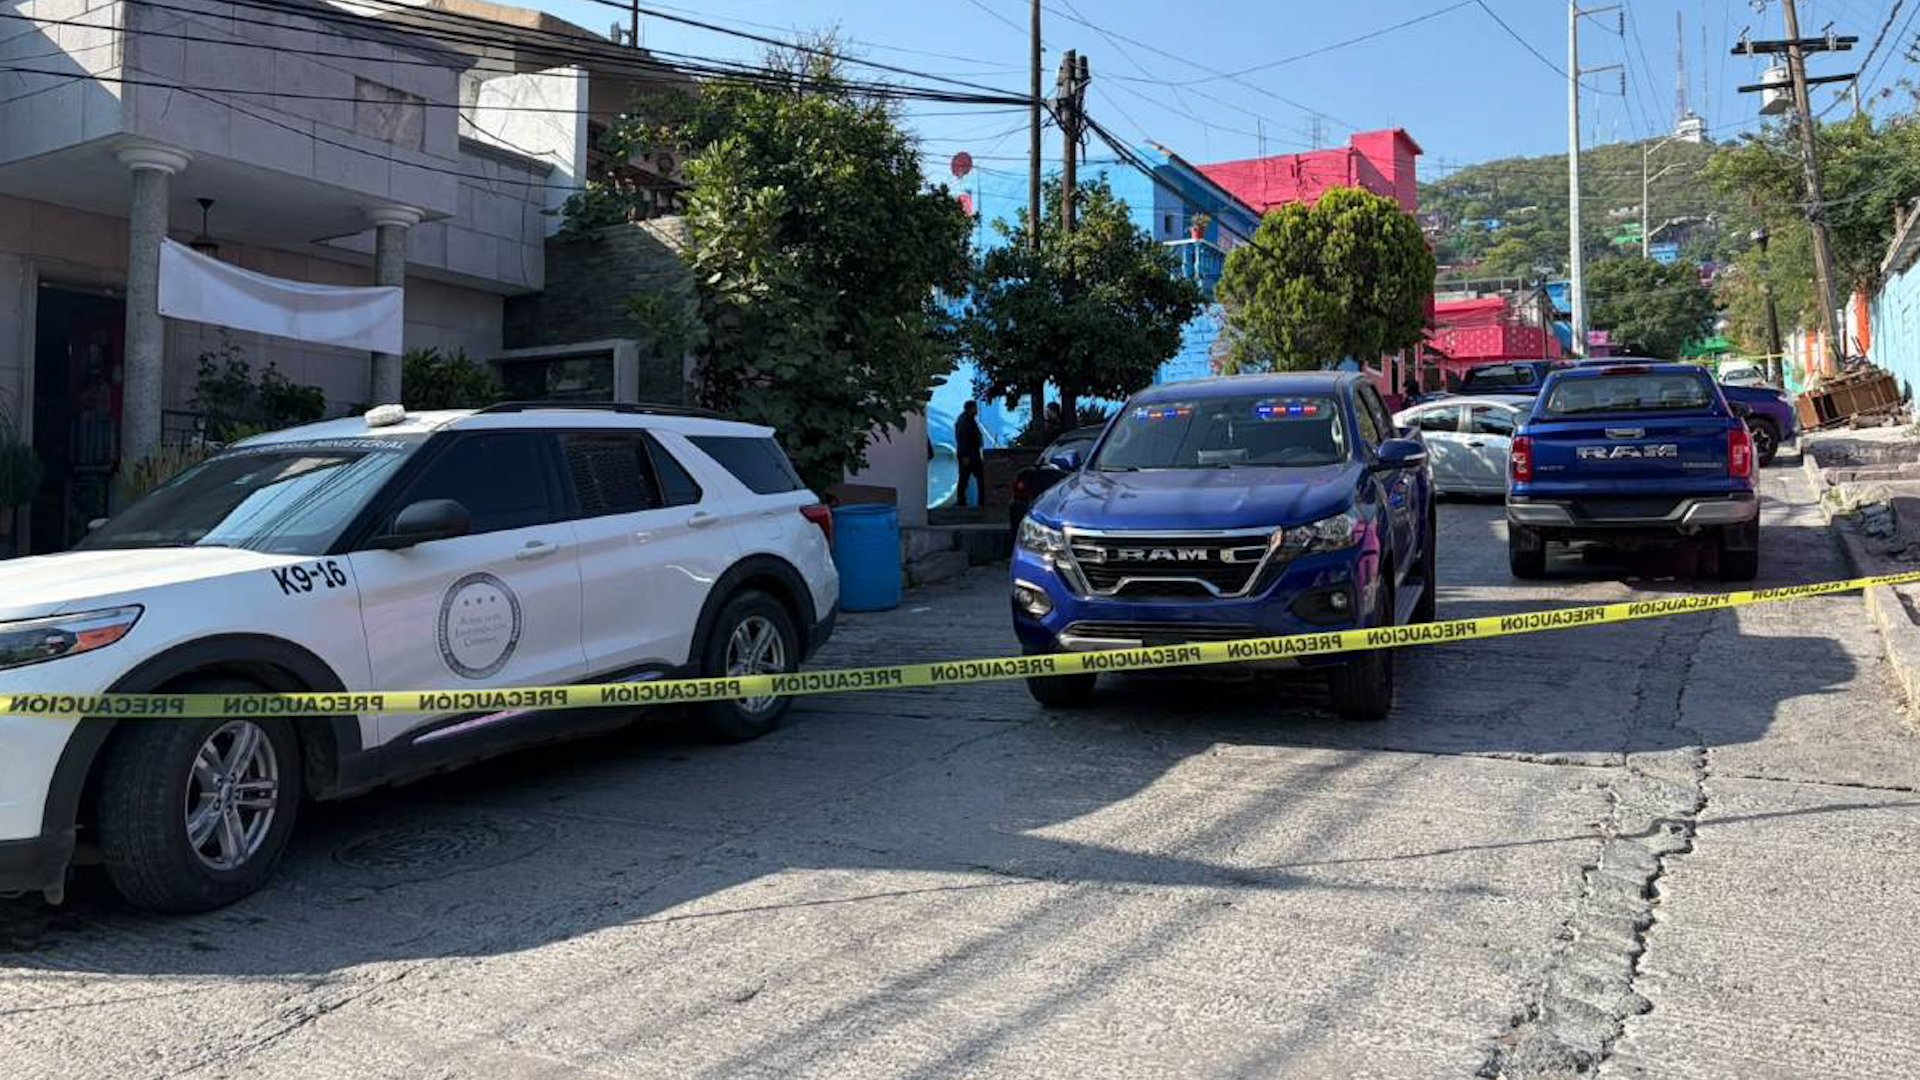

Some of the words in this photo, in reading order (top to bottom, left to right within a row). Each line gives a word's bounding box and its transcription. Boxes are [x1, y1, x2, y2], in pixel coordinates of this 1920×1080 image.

[1576, 444, 1678, 459] RAM
[1118, 549, 1208, 561] RAM
[271, 561, 346, 595] K9-16
